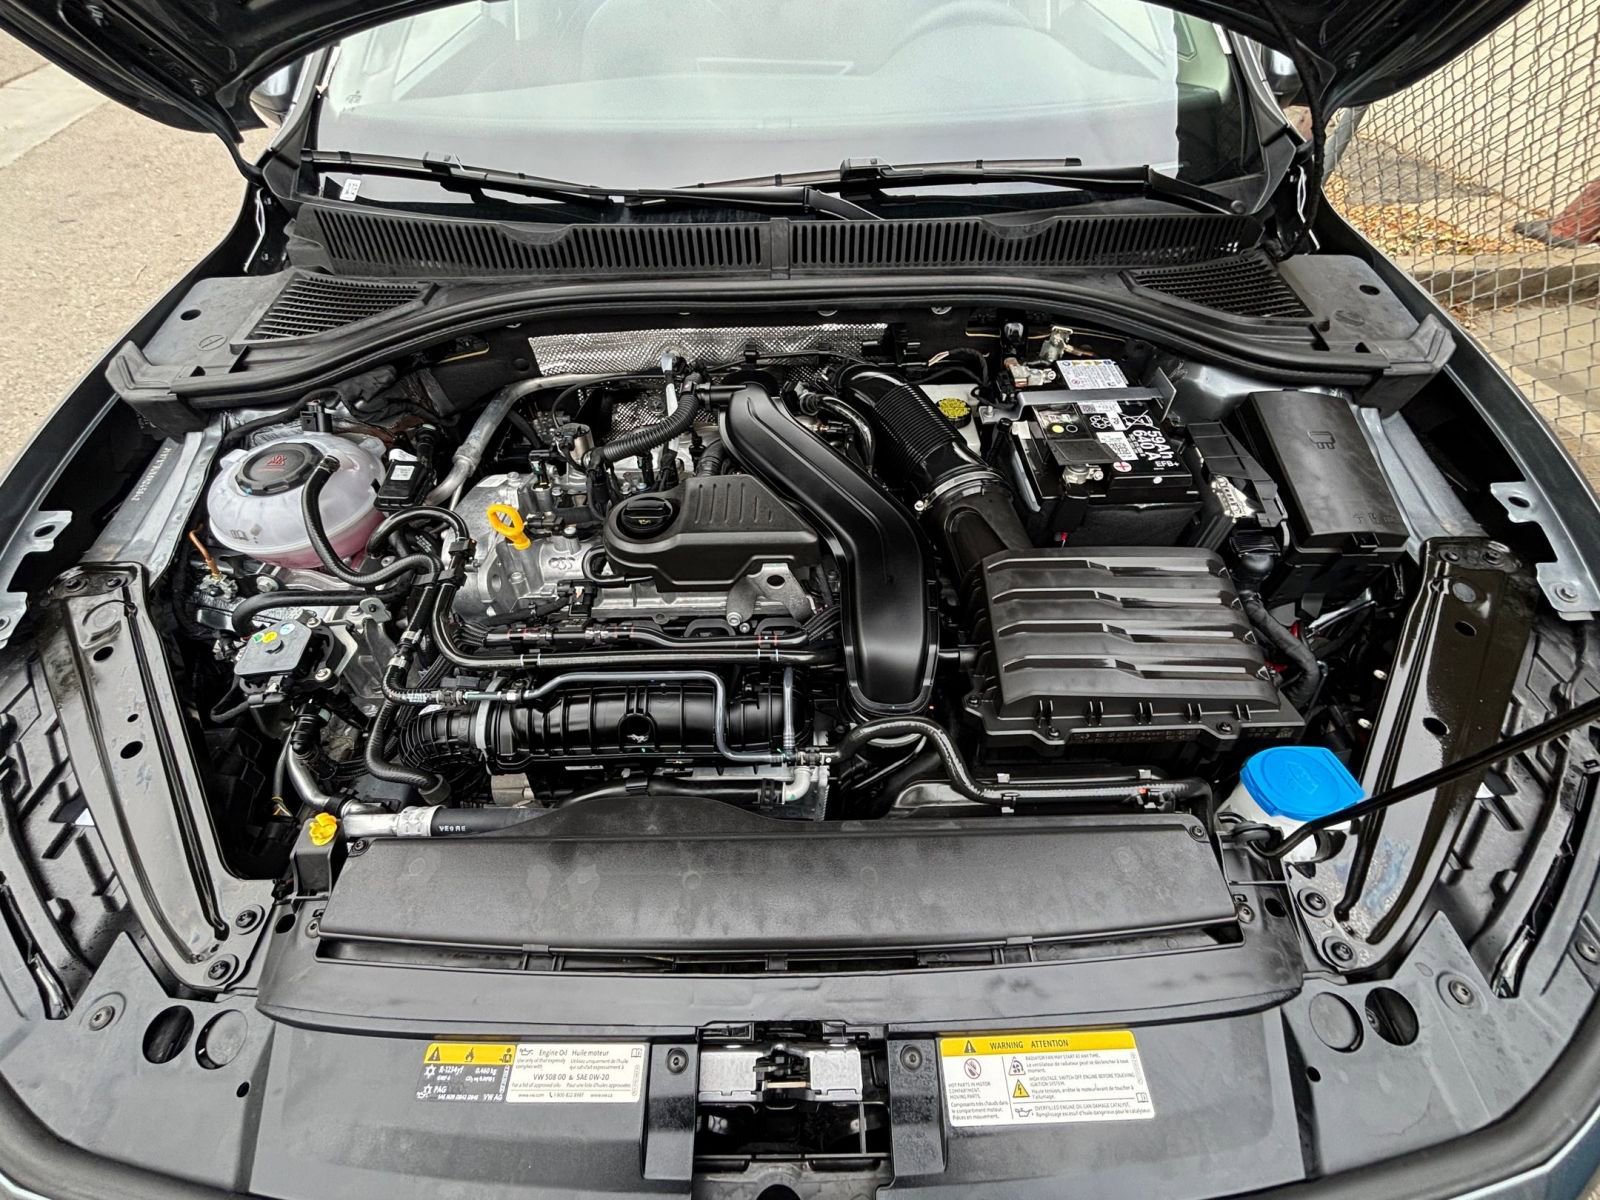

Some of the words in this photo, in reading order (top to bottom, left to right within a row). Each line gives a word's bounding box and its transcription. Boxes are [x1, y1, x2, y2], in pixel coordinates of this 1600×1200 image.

[1133, 430, 1156, 450] 640
[1145, 451, 1161, 460] A
[1147, 430, 1174, 459] 59Ah
[990, 1041, 1024, 1050] WARNING
[1031, 1040, 1068, 1048] ATTENTION
[539, 1049, 558, 1058] Engine
[434, 1086, 447, 1094] PAG
[494, 1094, 503, 1102] AG
